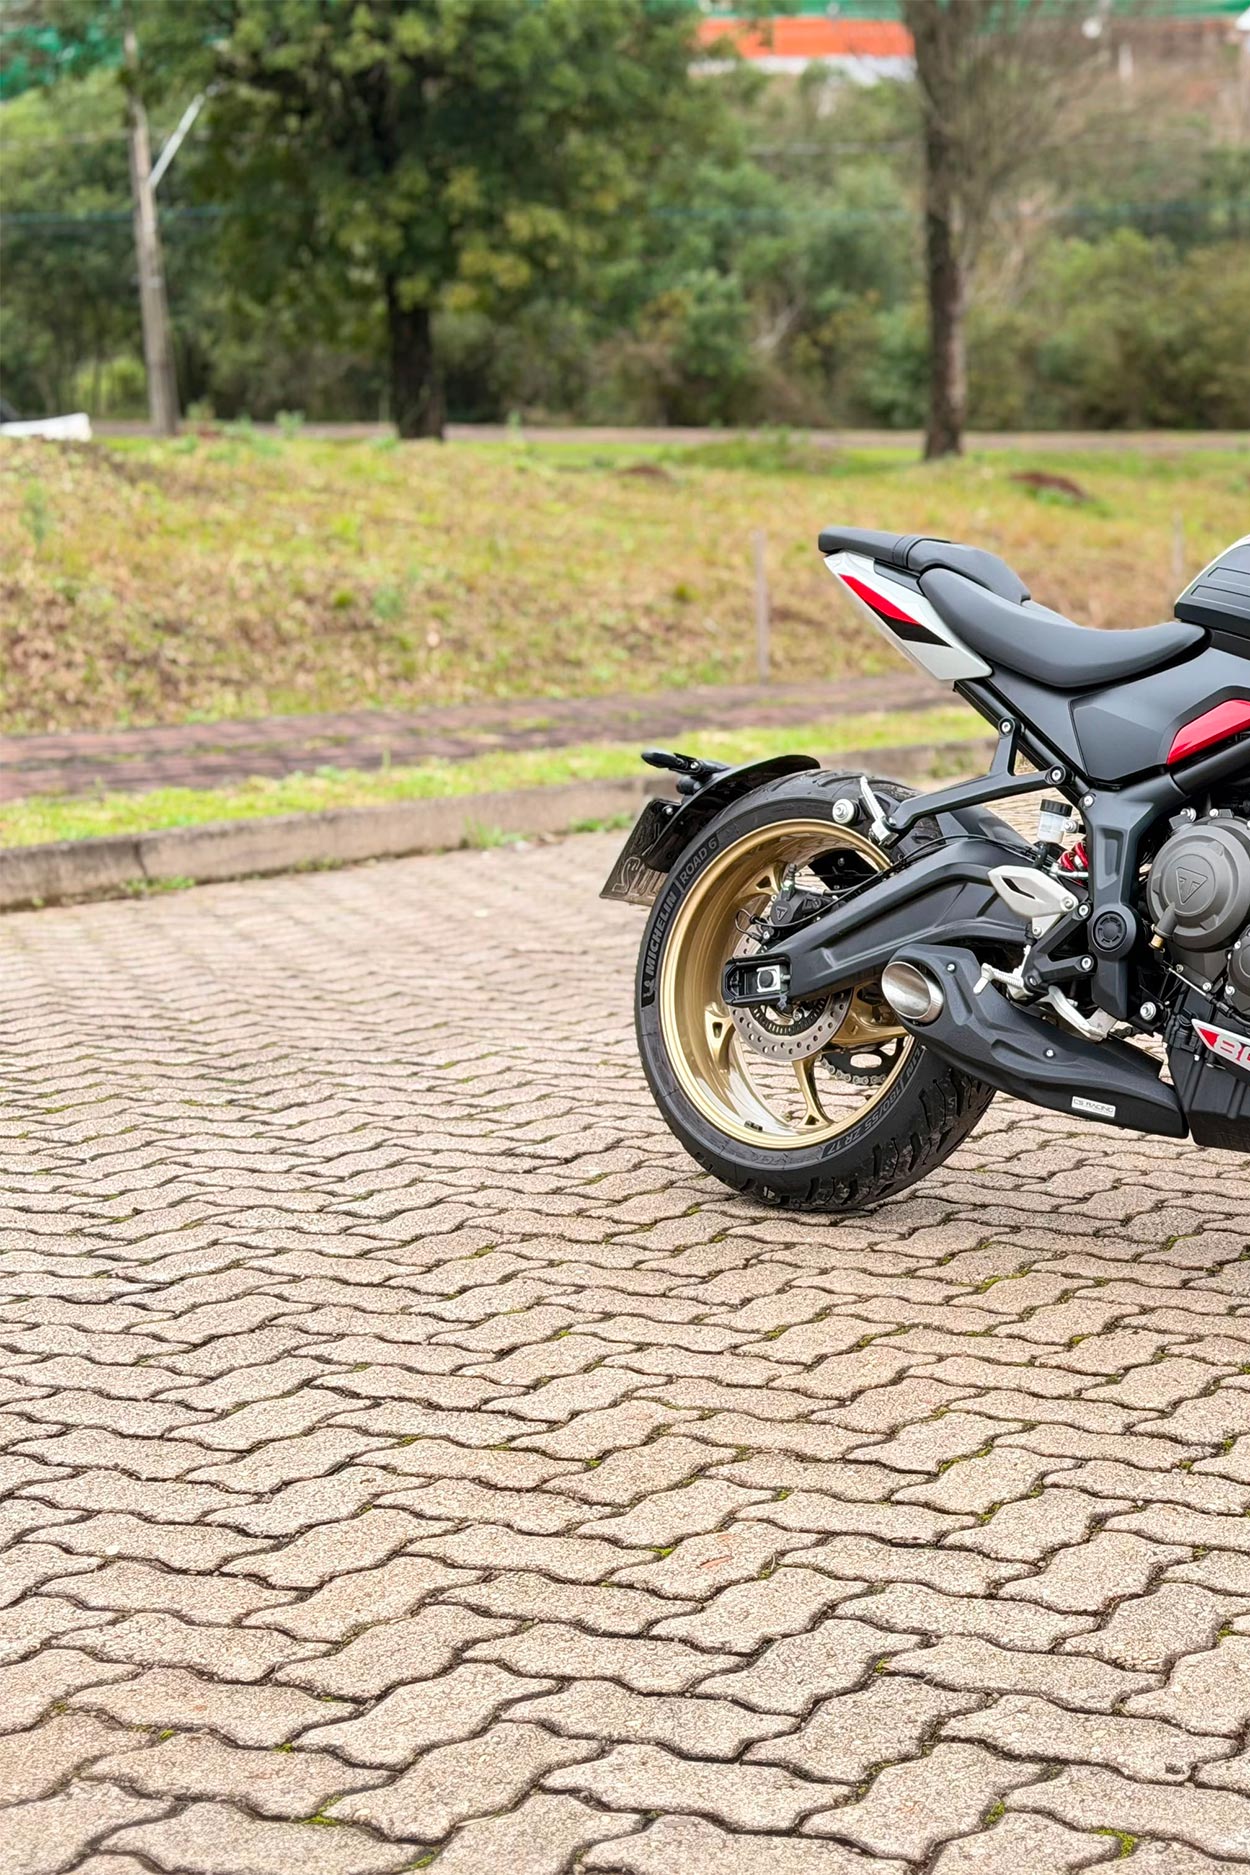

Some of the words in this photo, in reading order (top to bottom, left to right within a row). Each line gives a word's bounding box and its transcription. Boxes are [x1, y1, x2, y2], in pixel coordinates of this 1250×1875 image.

[645, 892, 677, 976] MICHELIN
[680, 848, 708, 885] ROAD
[708, 837, 718, 850] 6
